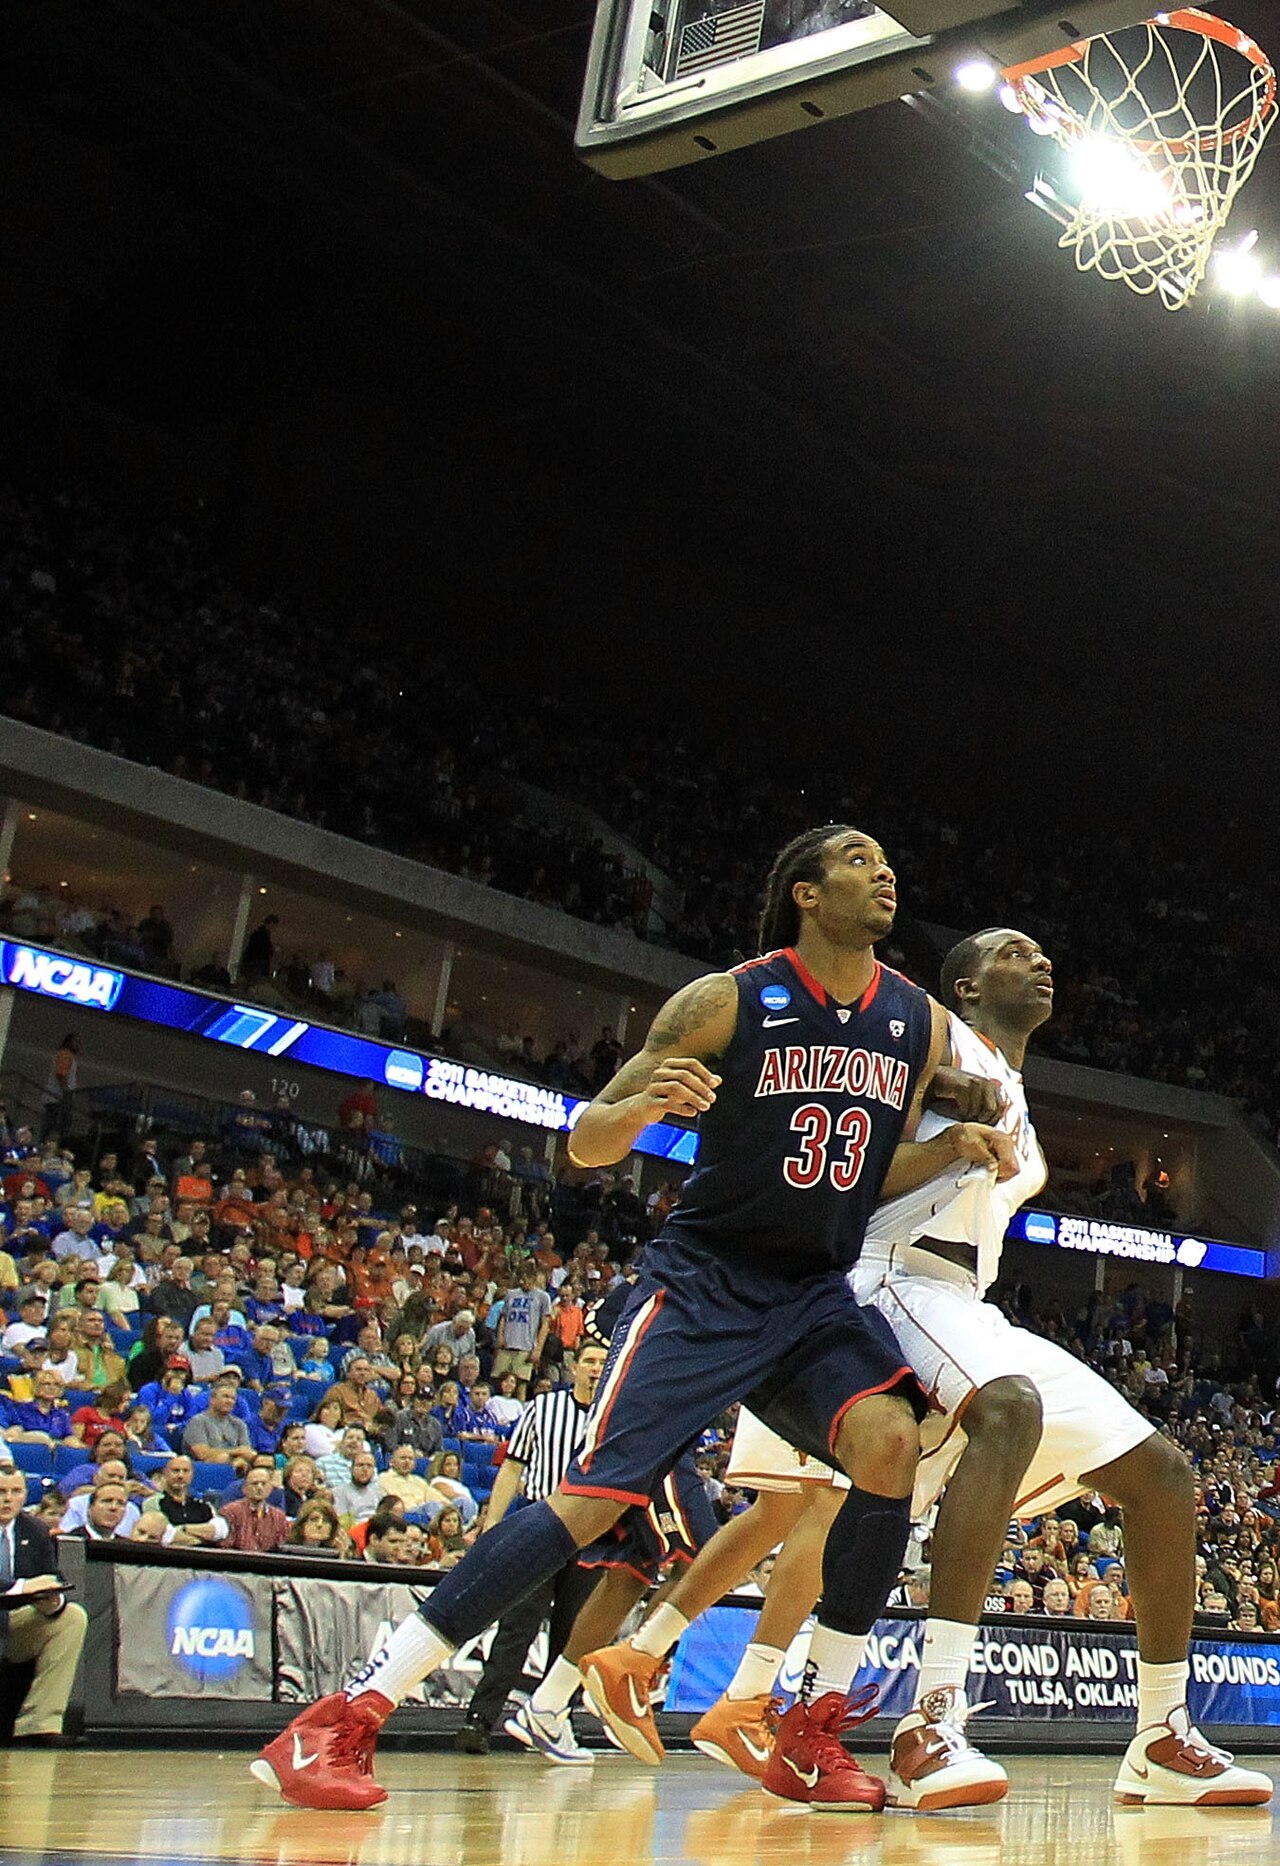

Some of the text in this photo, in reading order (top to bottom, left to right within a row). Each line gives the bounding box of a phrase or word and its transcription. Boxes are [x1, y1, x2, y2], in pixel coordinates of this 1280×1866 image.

[9, 949, 115, 1006] NCAA
[271, 1079, 299, 1097] 120
[428, 1059, 465, 1085] 2011
[464, 1069, 567, 1112] BASKETBALL
[754, 1046, 909, 1111] ARIZONA
[424, 1078, 567, 1130] CHAMPIONSHIP
[783, 1103, 871, 1191] 33
[1058, 1231, 1176, 1264] CHAMPIONSHIP
[1060, 1217, 1088, 1236] 2011
[1090, 1222, 1175, 1249] BASKETBALL
[984, 1596, 1006, 1612] OSS
[171, 1626, 255, 1659] NCAA
[860, 1636, 921, 1670] NCA
[970, 1641, 1060, 1676] ECOND
[1065, 1646, 1119, 1680] AND
[1192, 1654, 1280, 1686] ROUNDS
[1005, 1680, 1138, 1710] TULSA, OKLAH
